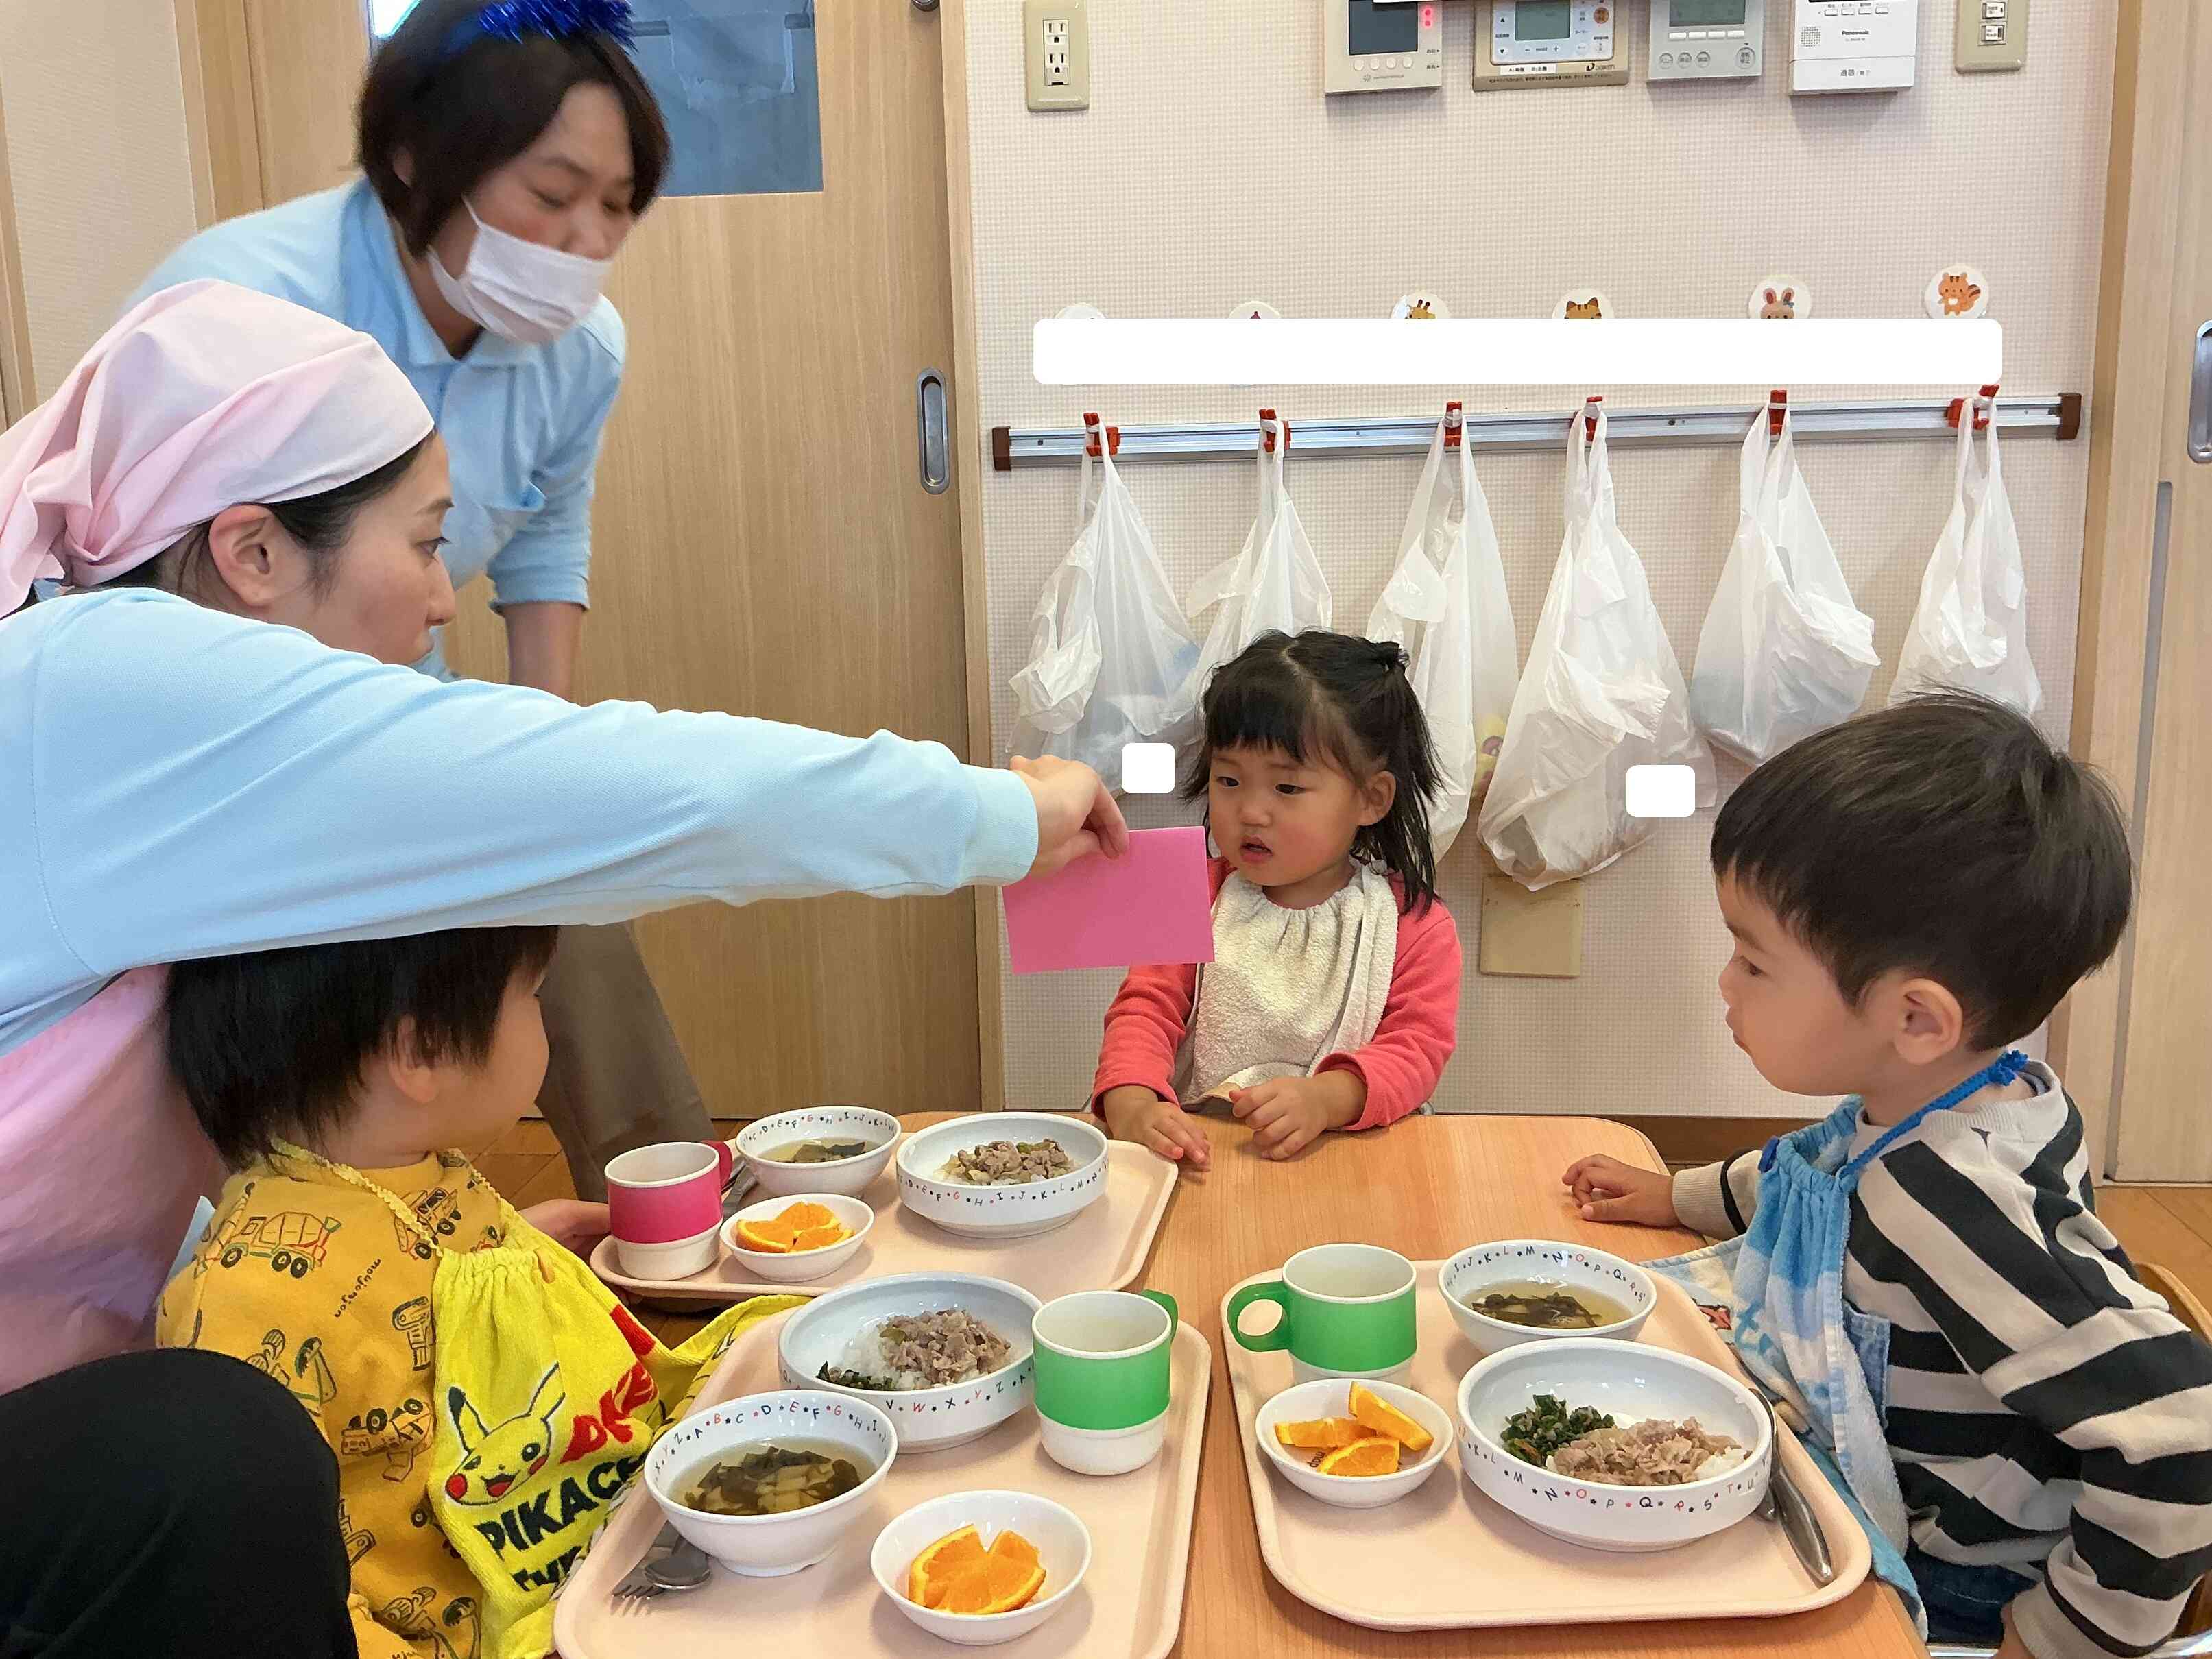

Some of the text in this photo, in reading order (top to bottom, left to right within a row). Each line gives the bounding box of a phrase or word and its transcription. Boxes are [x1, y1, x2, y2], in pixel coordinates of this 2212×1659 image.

[761, 1125, 769, 1133] D
[953, 1191, 960, 1200] G
[974, 1198, 983, 1207] H
[996, 1191, 1004, 1201] I
[1018, 1191, 1026, 1200] J
[1040, 1190, 1048, 1200] K
[1484, 1252, 1492, 1263] K
[1526, 1246, 1535, 1256] M
[1552, 1252, 1563, 1263] N
[1575, 1253, 1585, 1263] O
[1594, 1263, 1601, 1272] P
[1613, 1268, 1622, 1281] Q
[885, 1399, 894, 1410] V
[913, 1402, 926, 1413] W
[945, 1397, 956, 1409] X
[974, 1389, 982, 1399] Y
[996, 1381, 1004, 1394] Z
[673, 1432, 684, 1445] Z
[694, 1428, 703, 1439] A
[714, 1413, 721, 1425] B
[736, 1413, 744, 1424] C
[760, 1405, 771, 1416] D
[789, 1401, 800, 1413] E
[813, 1407, 820, 1420] F
[834, 1405, 842, 1416] G
[854, 1416, 863, 1430] H
[1513, 1471, 1524, 1485] M
[1544, 1488, 1559, 1501] N
[1576, 1488, 1587, 1499] O
[1606, 1499, 1615, 1509] P
[1639, 1497, 1654, 1508] Q
[1674, 1499, 1685, 1512] R
[1704, 1499, 1712, 1511] S
[1726, 1483, 1733, 1494] T
